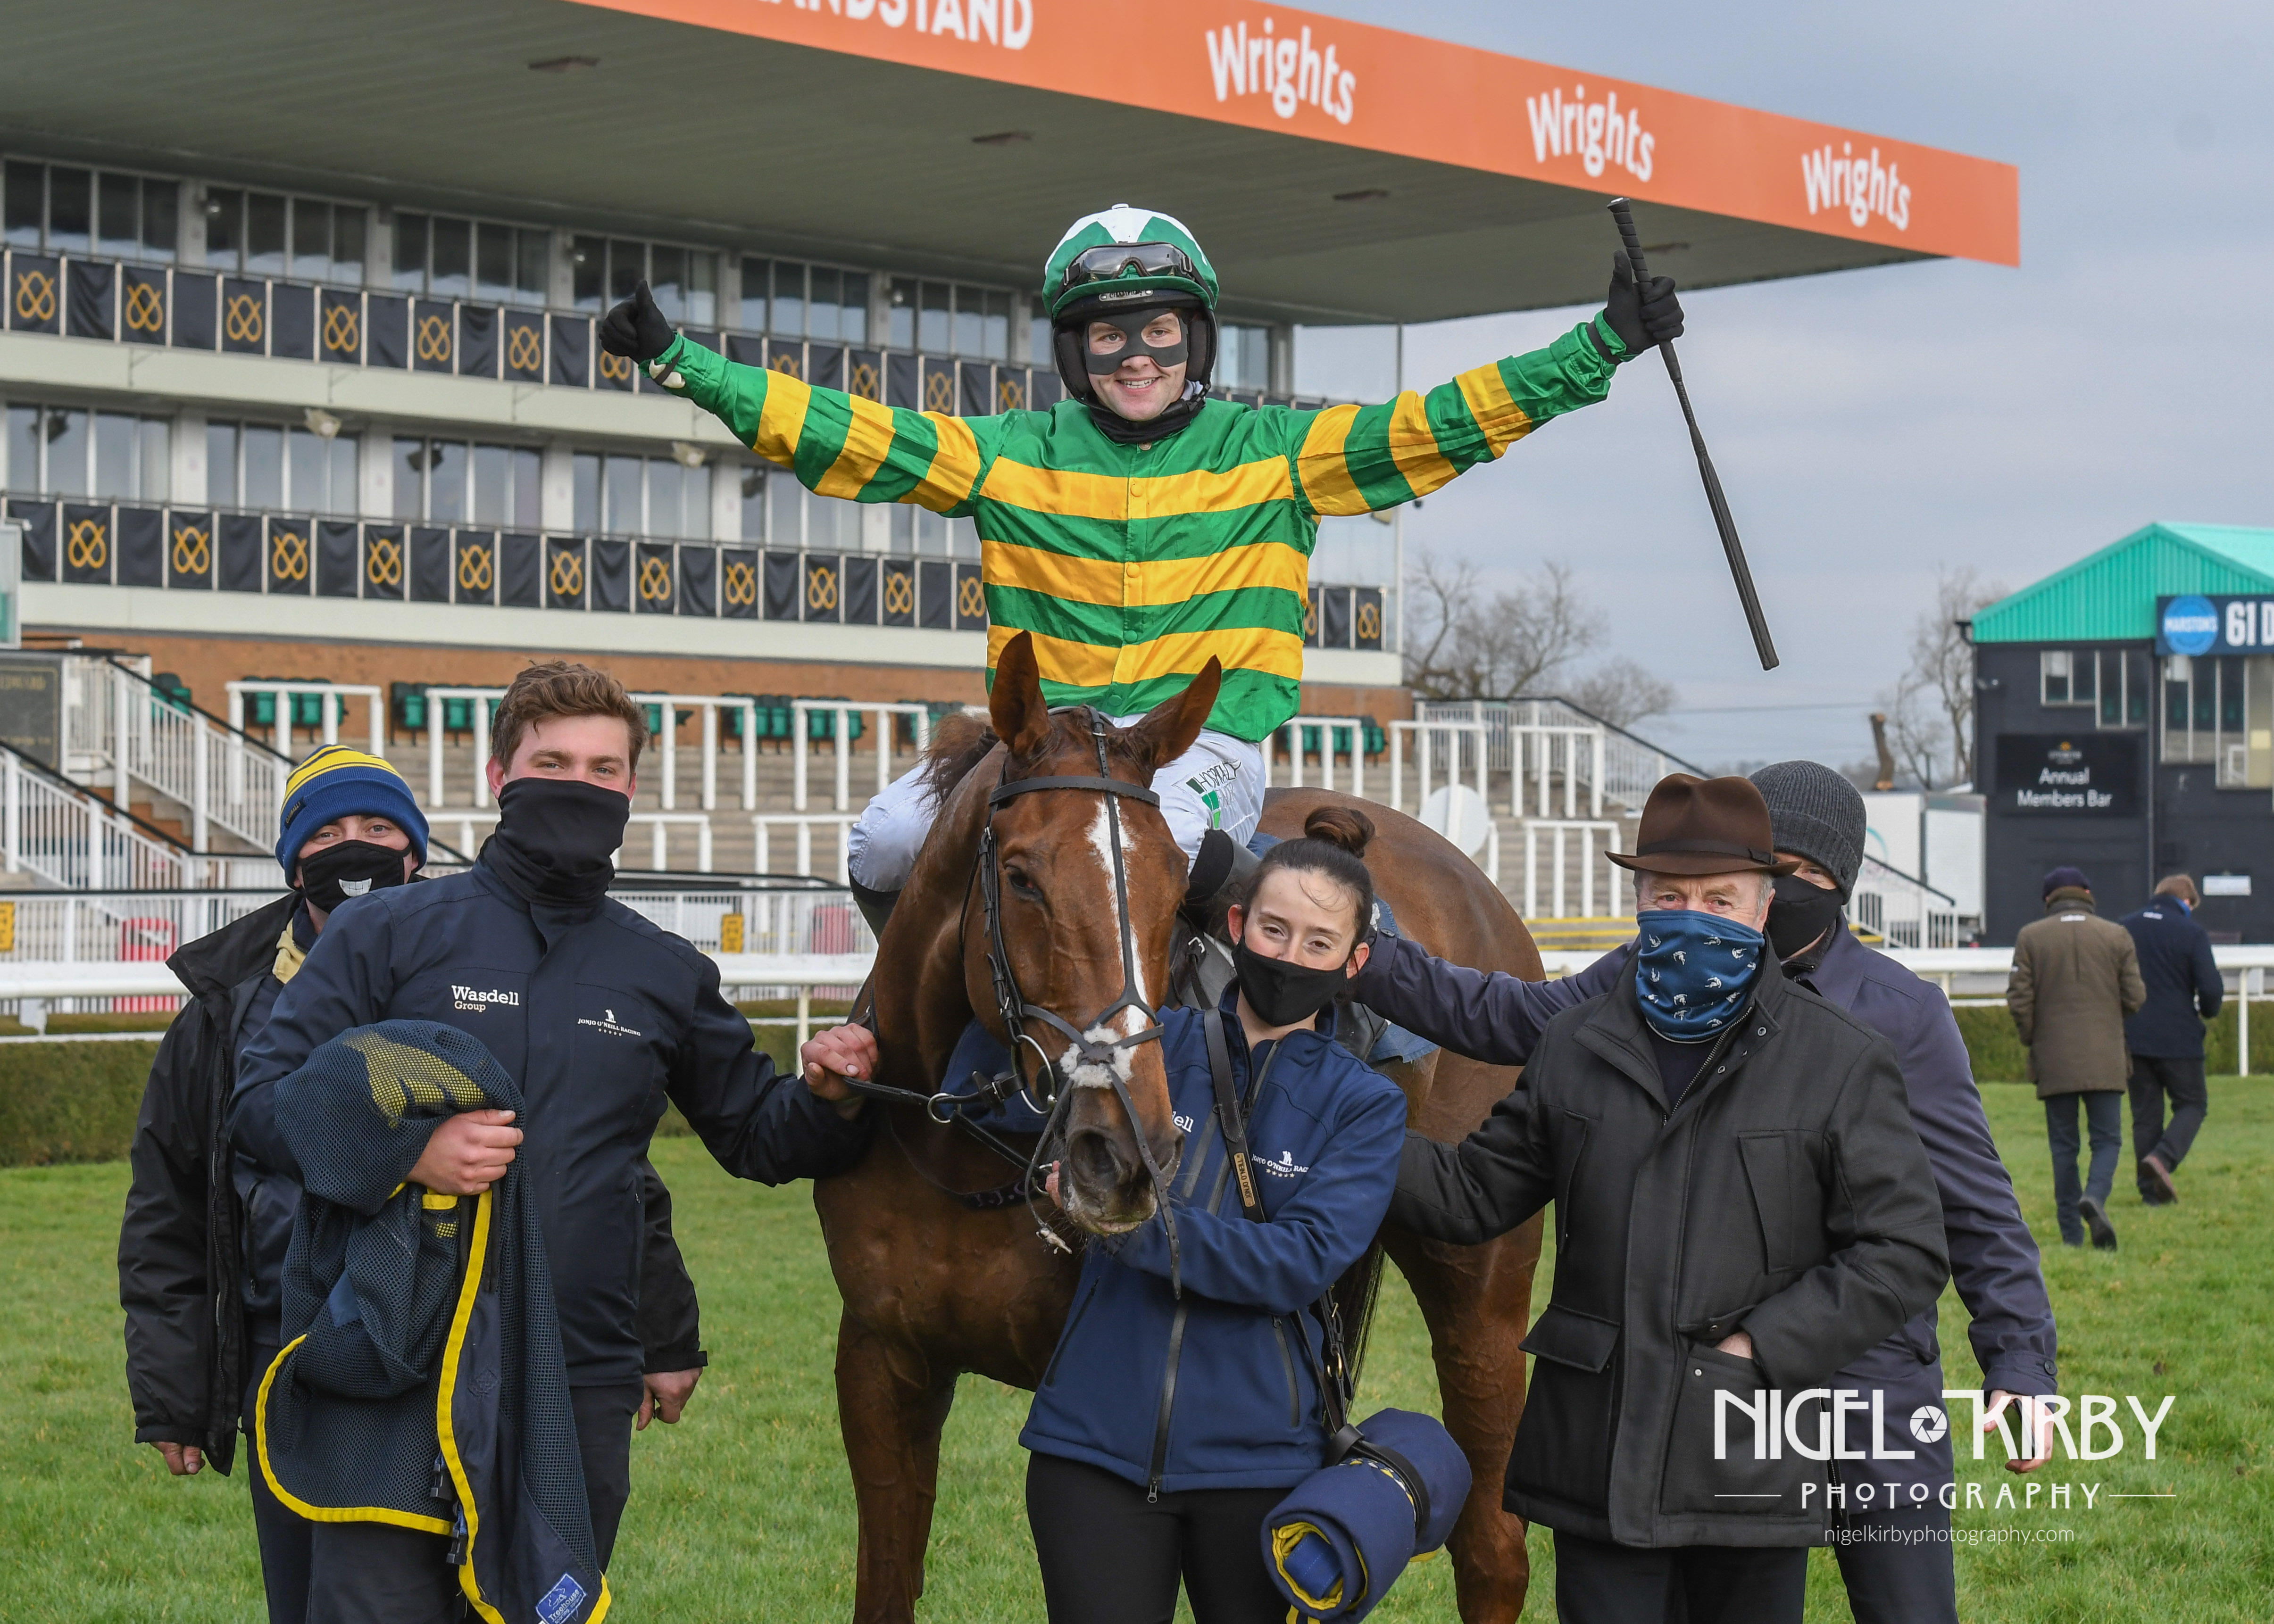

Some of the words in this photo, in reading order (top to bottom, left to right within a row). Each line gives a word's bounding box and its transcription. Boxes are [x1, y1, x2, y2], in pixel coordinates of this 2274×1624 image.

[1206, 17, 1356, 125] Wrights
[1527, 85, 1655, 182] Wrights
[1802, 142, 1910, 230] Wrights
[2225, 601, 2257, 646] 61
[2038, 766, 2090, 785] Annual
[2017, 788, 2085, 807] Members
[2087, 789, 2113, 807] Bar
[451, 985, 519, 1005] Wasdell
[454, 1001, 486, 1012] Group
[597, 1021, 620, 1031] O'NEILL
[620, 1026, 641, 1036] RACING
[548, 1589, 579, 1620] Treehouse
